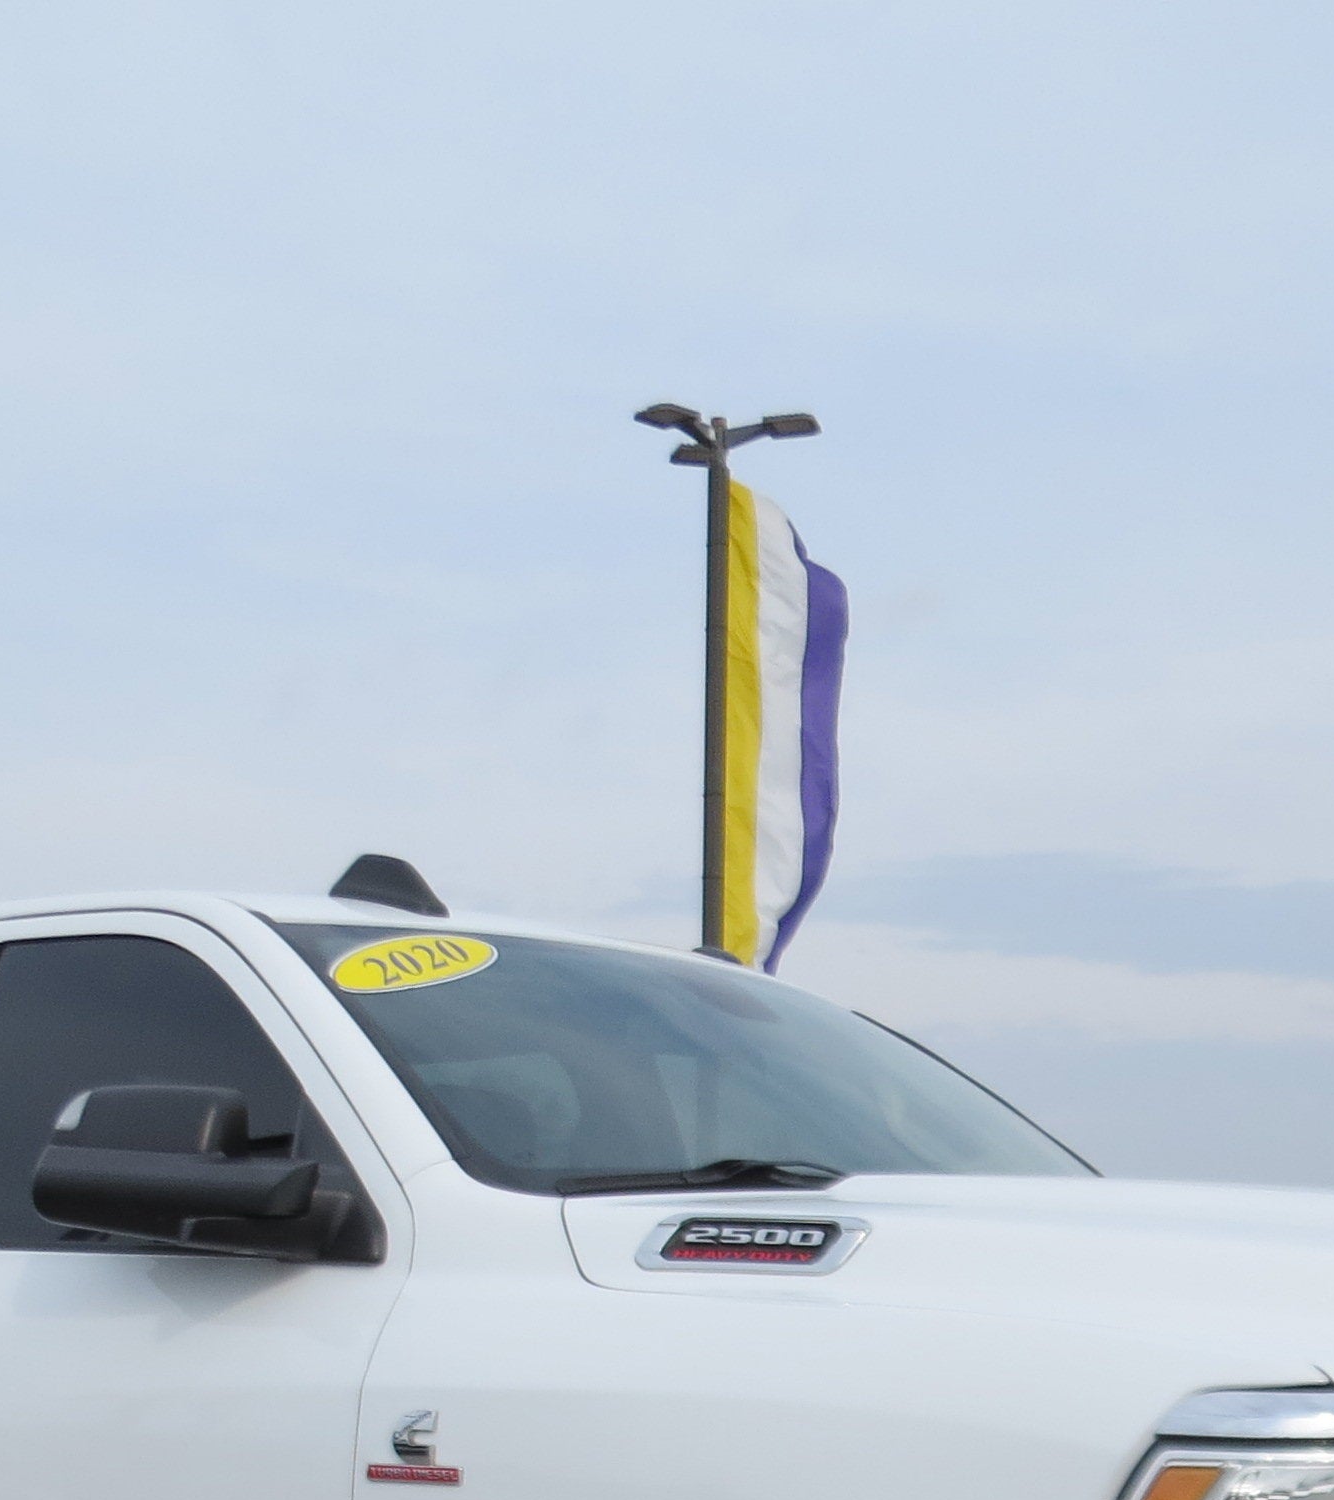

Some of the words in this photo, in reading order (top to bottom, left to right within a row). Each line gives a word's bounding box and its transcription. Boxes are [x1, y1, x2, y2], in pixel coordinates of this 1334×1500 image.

[363, 939, 469, 985] 2020
[684, 1226, 825, 1247] 2500
[674, 1249, 747, 1260] HEAVY
[750, 1250, 813, 1262] DUTY
[370, 1466, 411, 1479] TURBO
[412, 1468, 458, 1481] DIESEL
